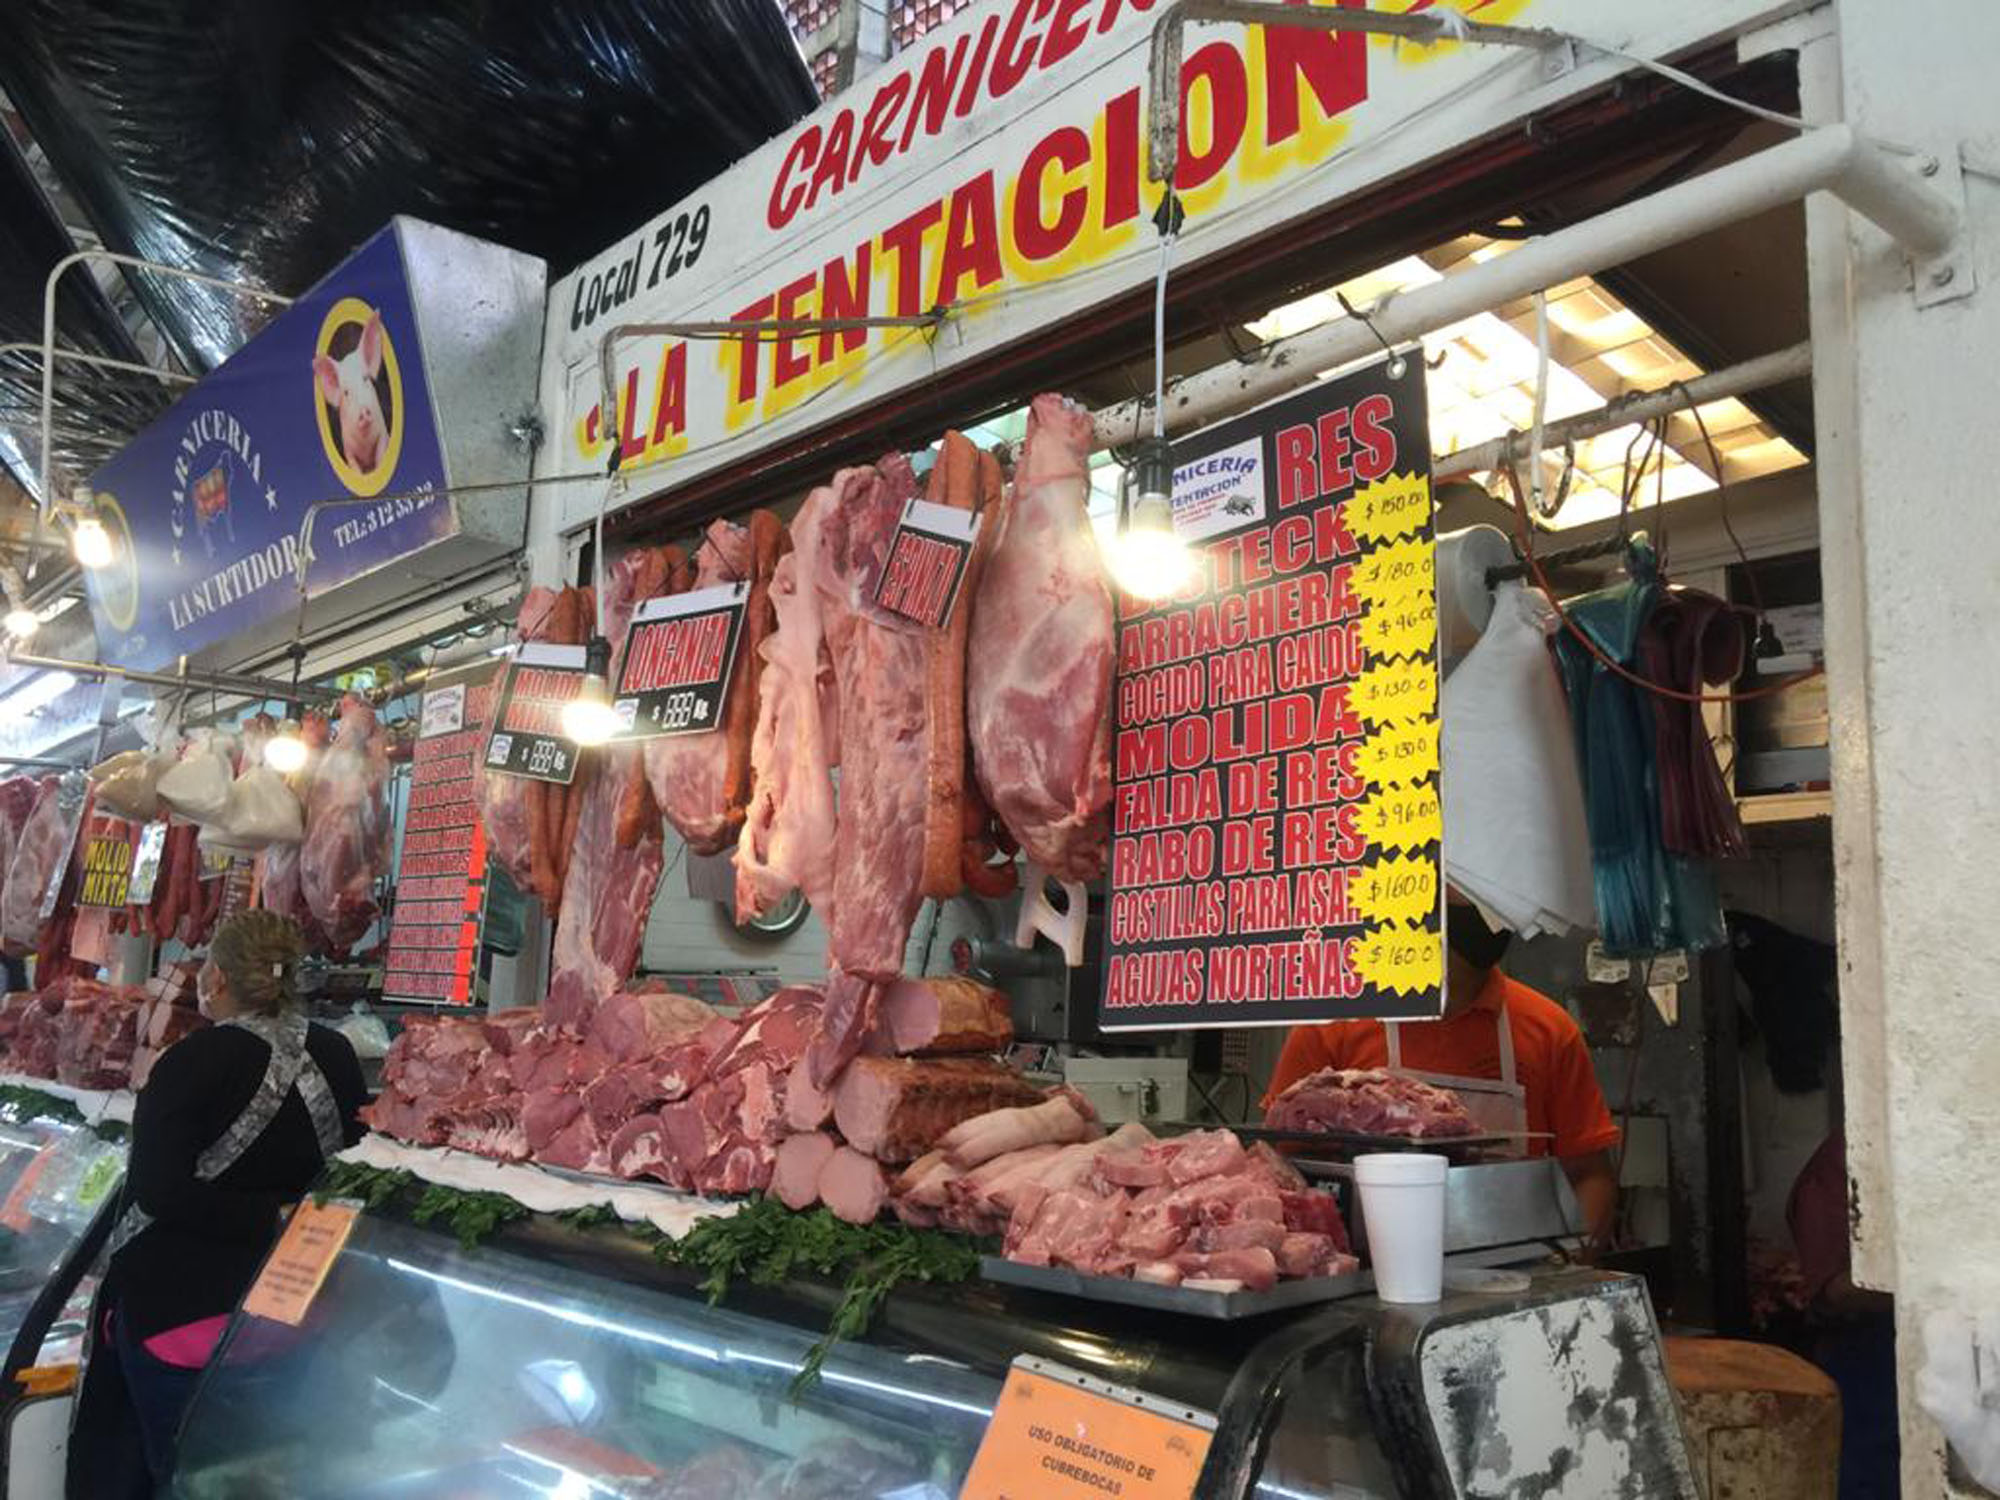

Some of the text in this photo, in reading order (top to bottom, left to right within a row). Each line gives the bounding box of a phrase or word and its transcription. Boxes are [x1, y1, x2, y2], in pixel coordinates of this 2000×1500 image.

[730, 0, 1368, 404] TENTACION
[571, 203, 710, 331] Local 729
[171, 410, 261, 538] CARNICERIA
[1275, 394, 1396, 509] RES
[621, 611, 732, 694] LONGANIZA
[1117, 562, 1361, 677] ARRACHERA
[1119, 619, 1365, 728] COCIDO PARA CALDO
[1116, 686, 1364, 781] MOLIDA
[1115, 741, 1367, 835] FALDA DE RES
[1113, 801, 1368, 889] RABO DE RES
[1111, 880, 1226, 946] COSTILLAS
[1226, 874, 1291, 934] PARA
[1105, 929, 1366, 1008] AGUJAS NORTEÑAS
[1028, 1424, 1156, 1482] USO OBLIGATORIO DE
[1041, 1454, 1123, 1497] CUBREBOCAS
